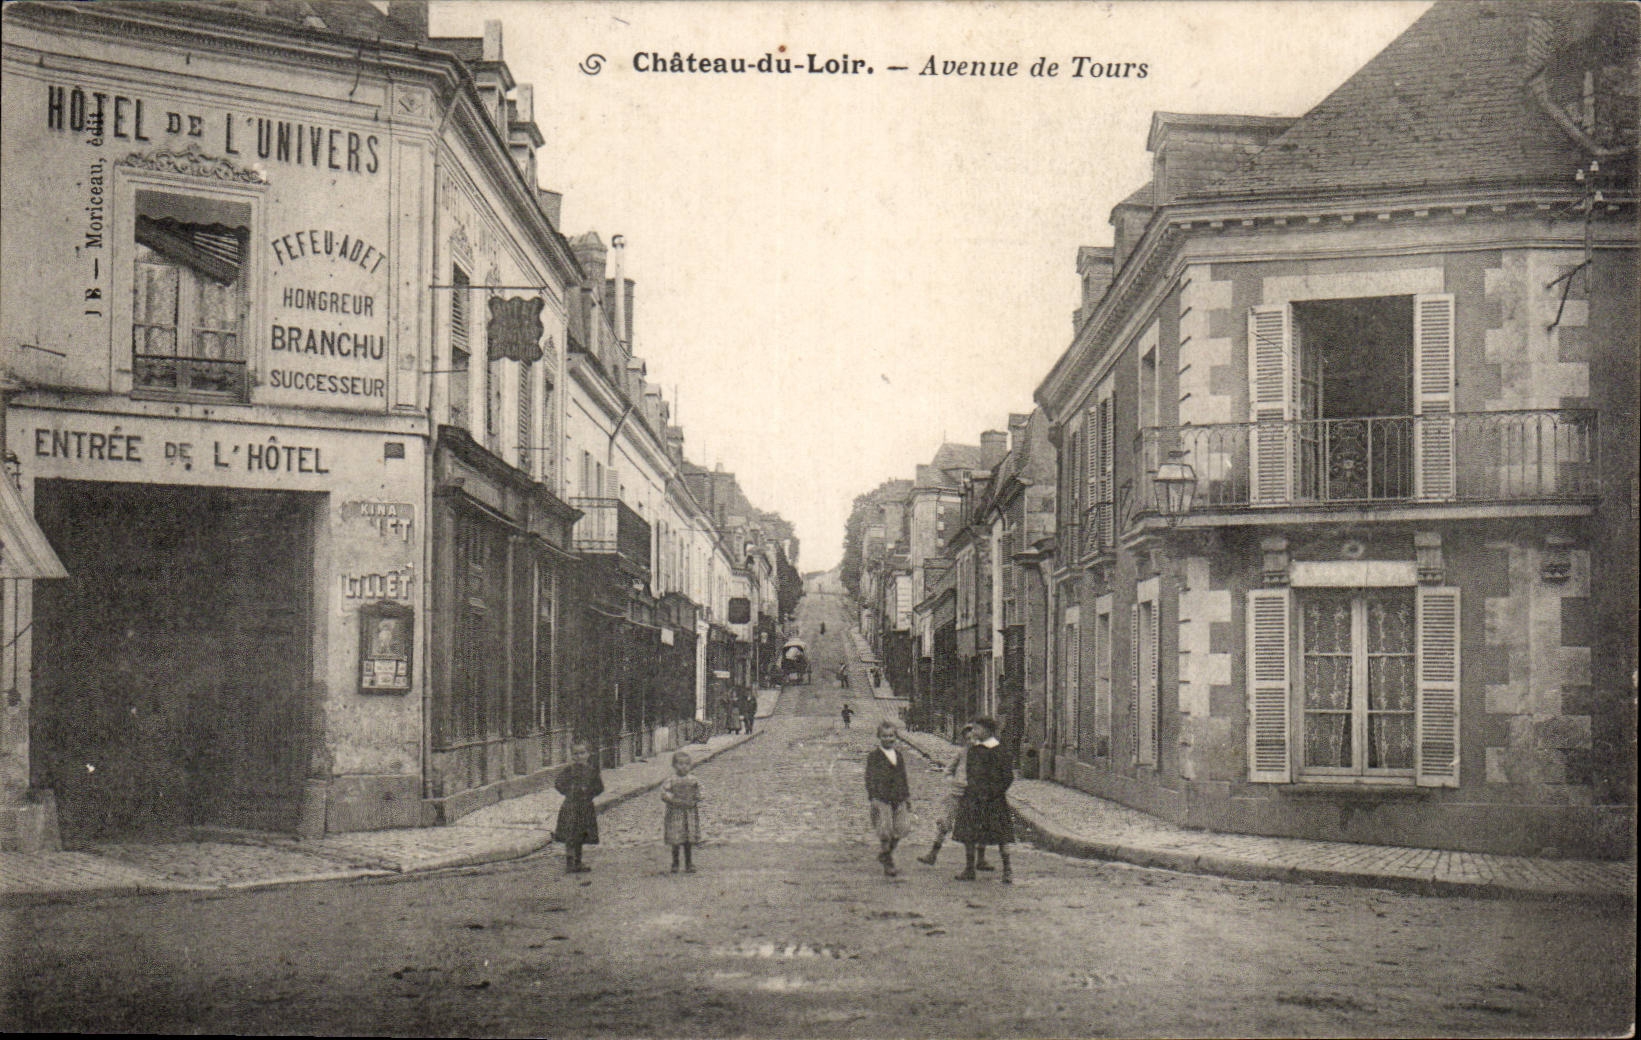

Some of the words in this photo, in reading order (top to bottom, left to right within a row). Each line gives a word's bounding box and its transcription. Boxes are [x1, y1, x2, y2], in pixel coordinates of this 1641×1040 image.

[48, 84, 151, 142] HÔTEL
[166, 111, 205, 138] DE
[225, 112, 380, 174] L'UNIVERS
[283, 286, 375, 318] HONGREUR
[271, 324, 385, 361] BRANCHU
[269, 369, 385, 398] SUCCESSEUR
[34, 425, 142, 463] ENTRÉE
[164, 441, 193, 460] DE
[214, 435, 330, 474] L'HÔTEL
[360, 503, 398, 517] KINA
